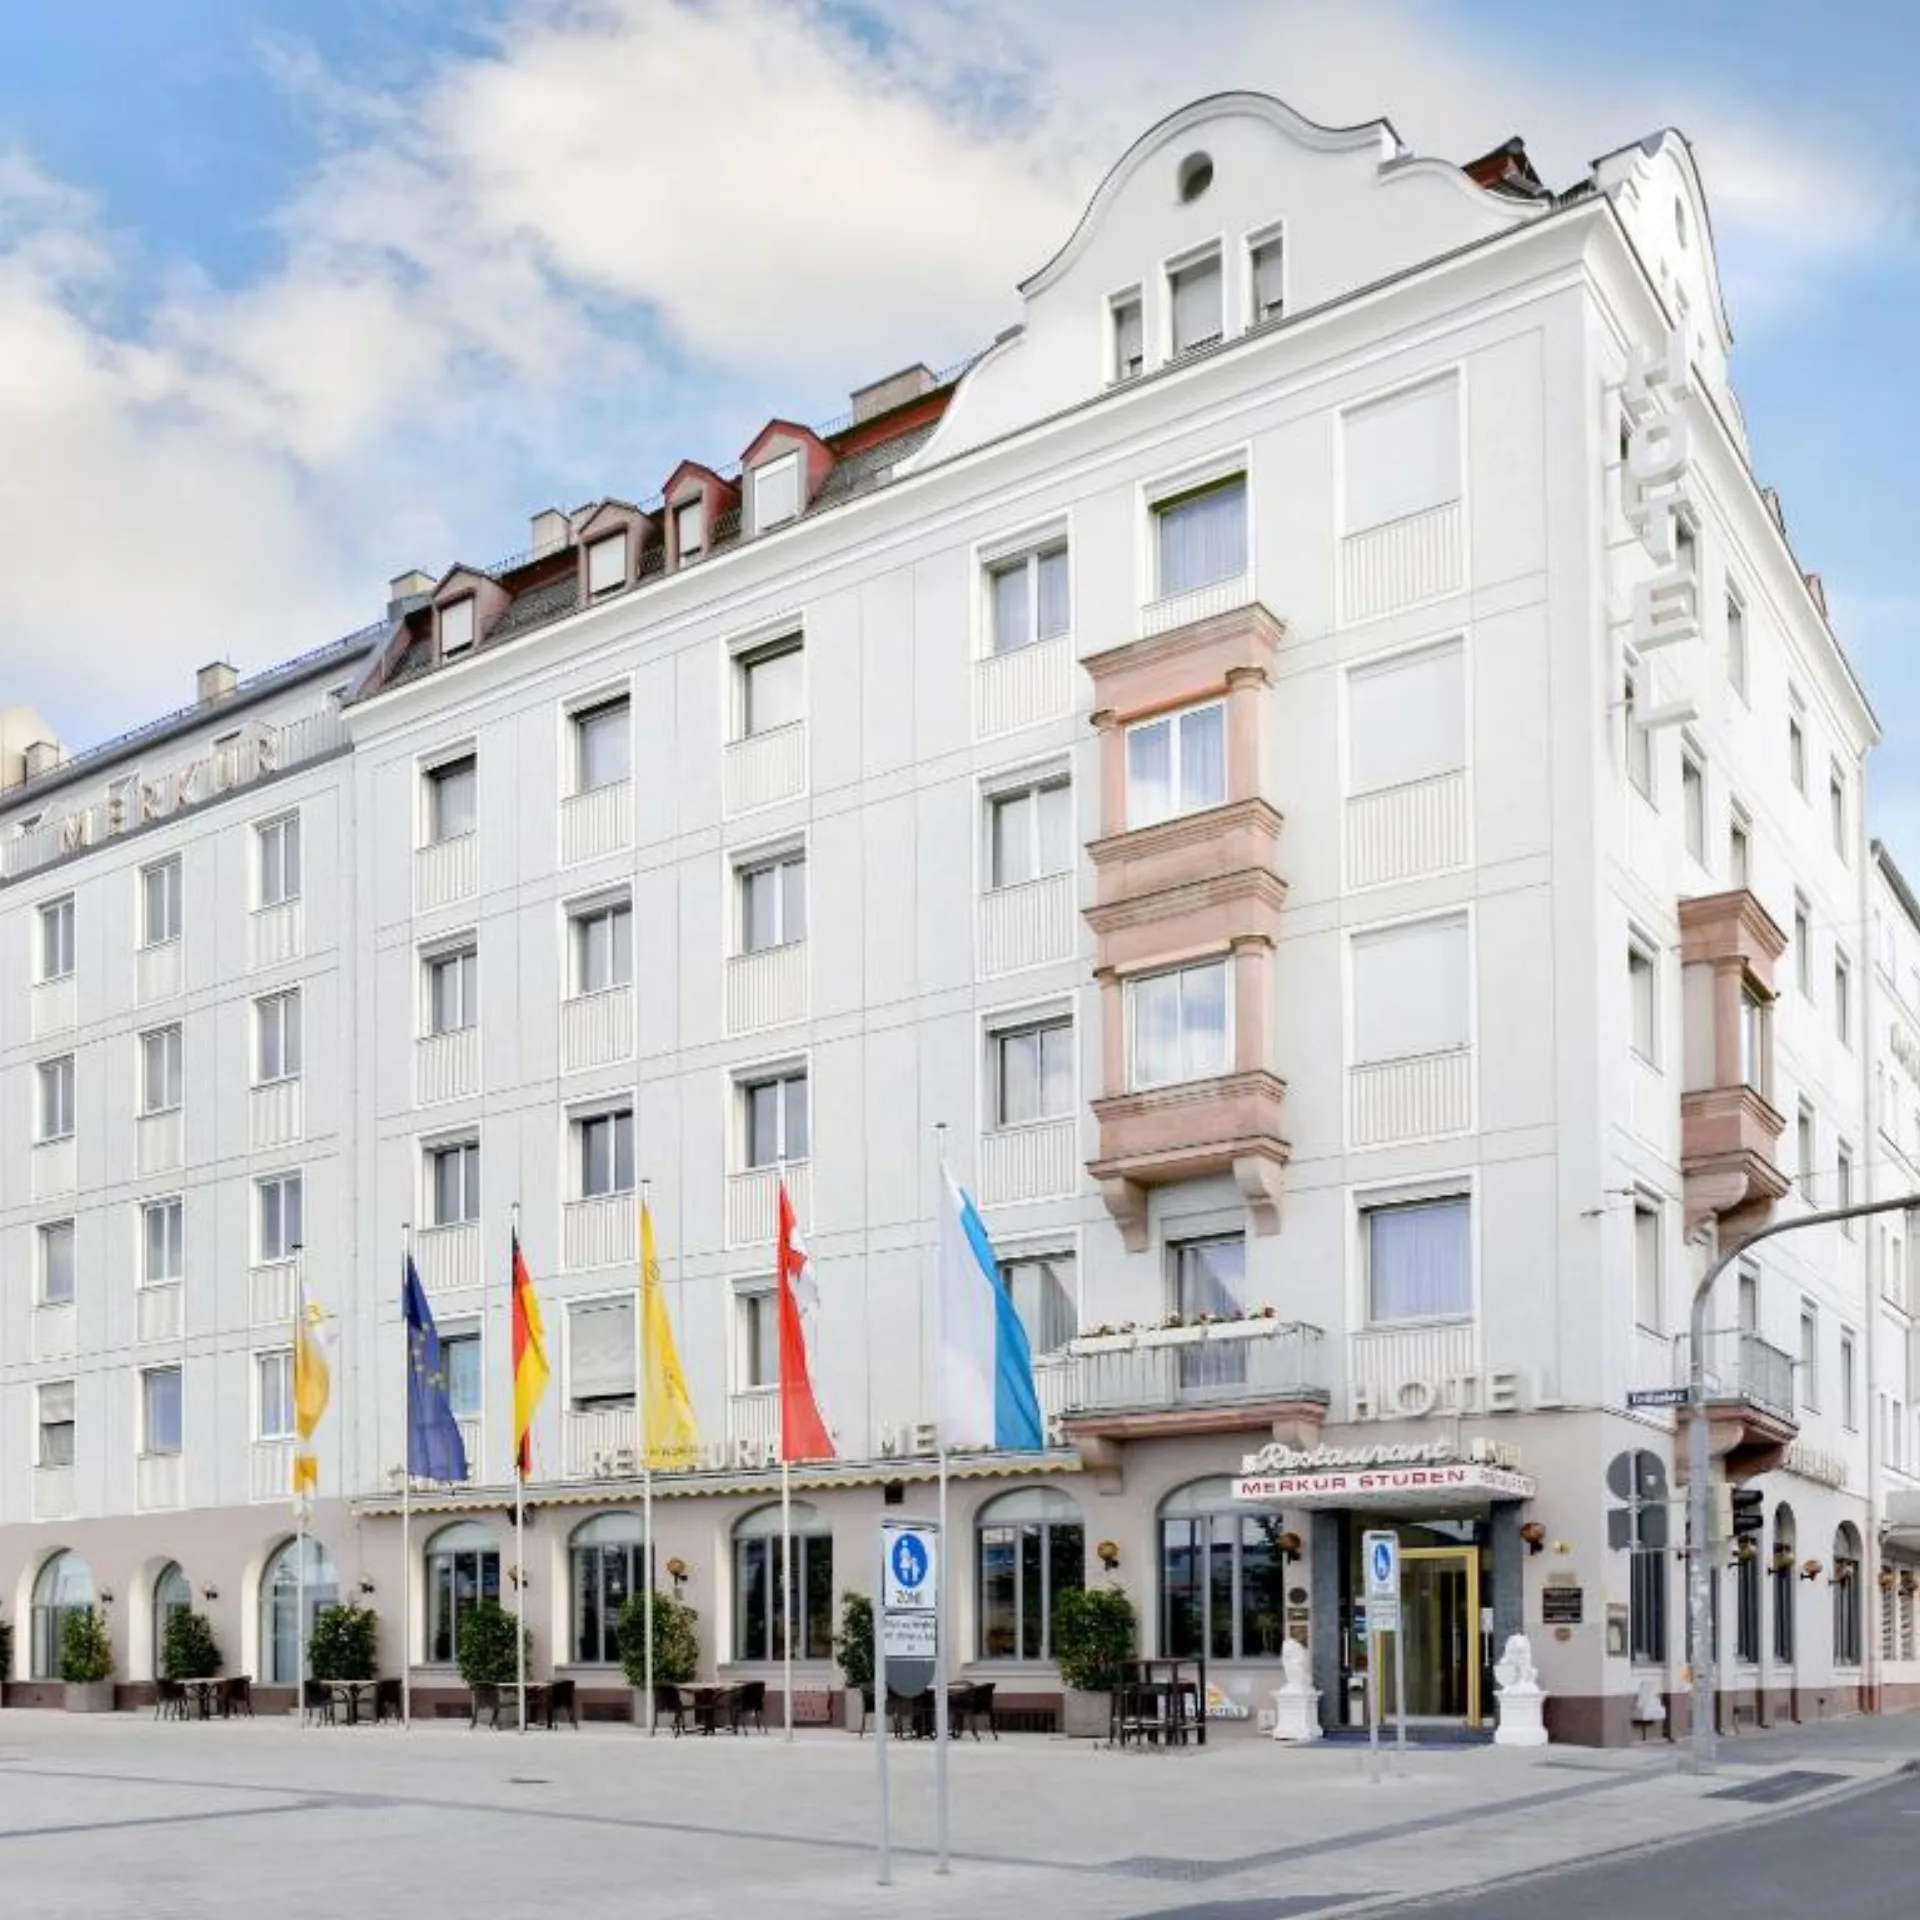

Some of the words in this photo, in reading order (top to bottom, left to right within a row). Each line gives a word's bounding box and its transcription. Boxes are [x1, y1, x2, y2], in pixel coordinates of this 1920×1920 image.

[1624, 320, 1700, 728] HOTEL
[62, 731, 279, 853] MERKUR
[1350, 1365, 1562, 1423] HOTEL
[1241, 1478, 1347, 1494] MERKUR
[1359, 1469, 1466, 1488] STUBEN
[1242, 1436, 1455, 1474] Restaurant
